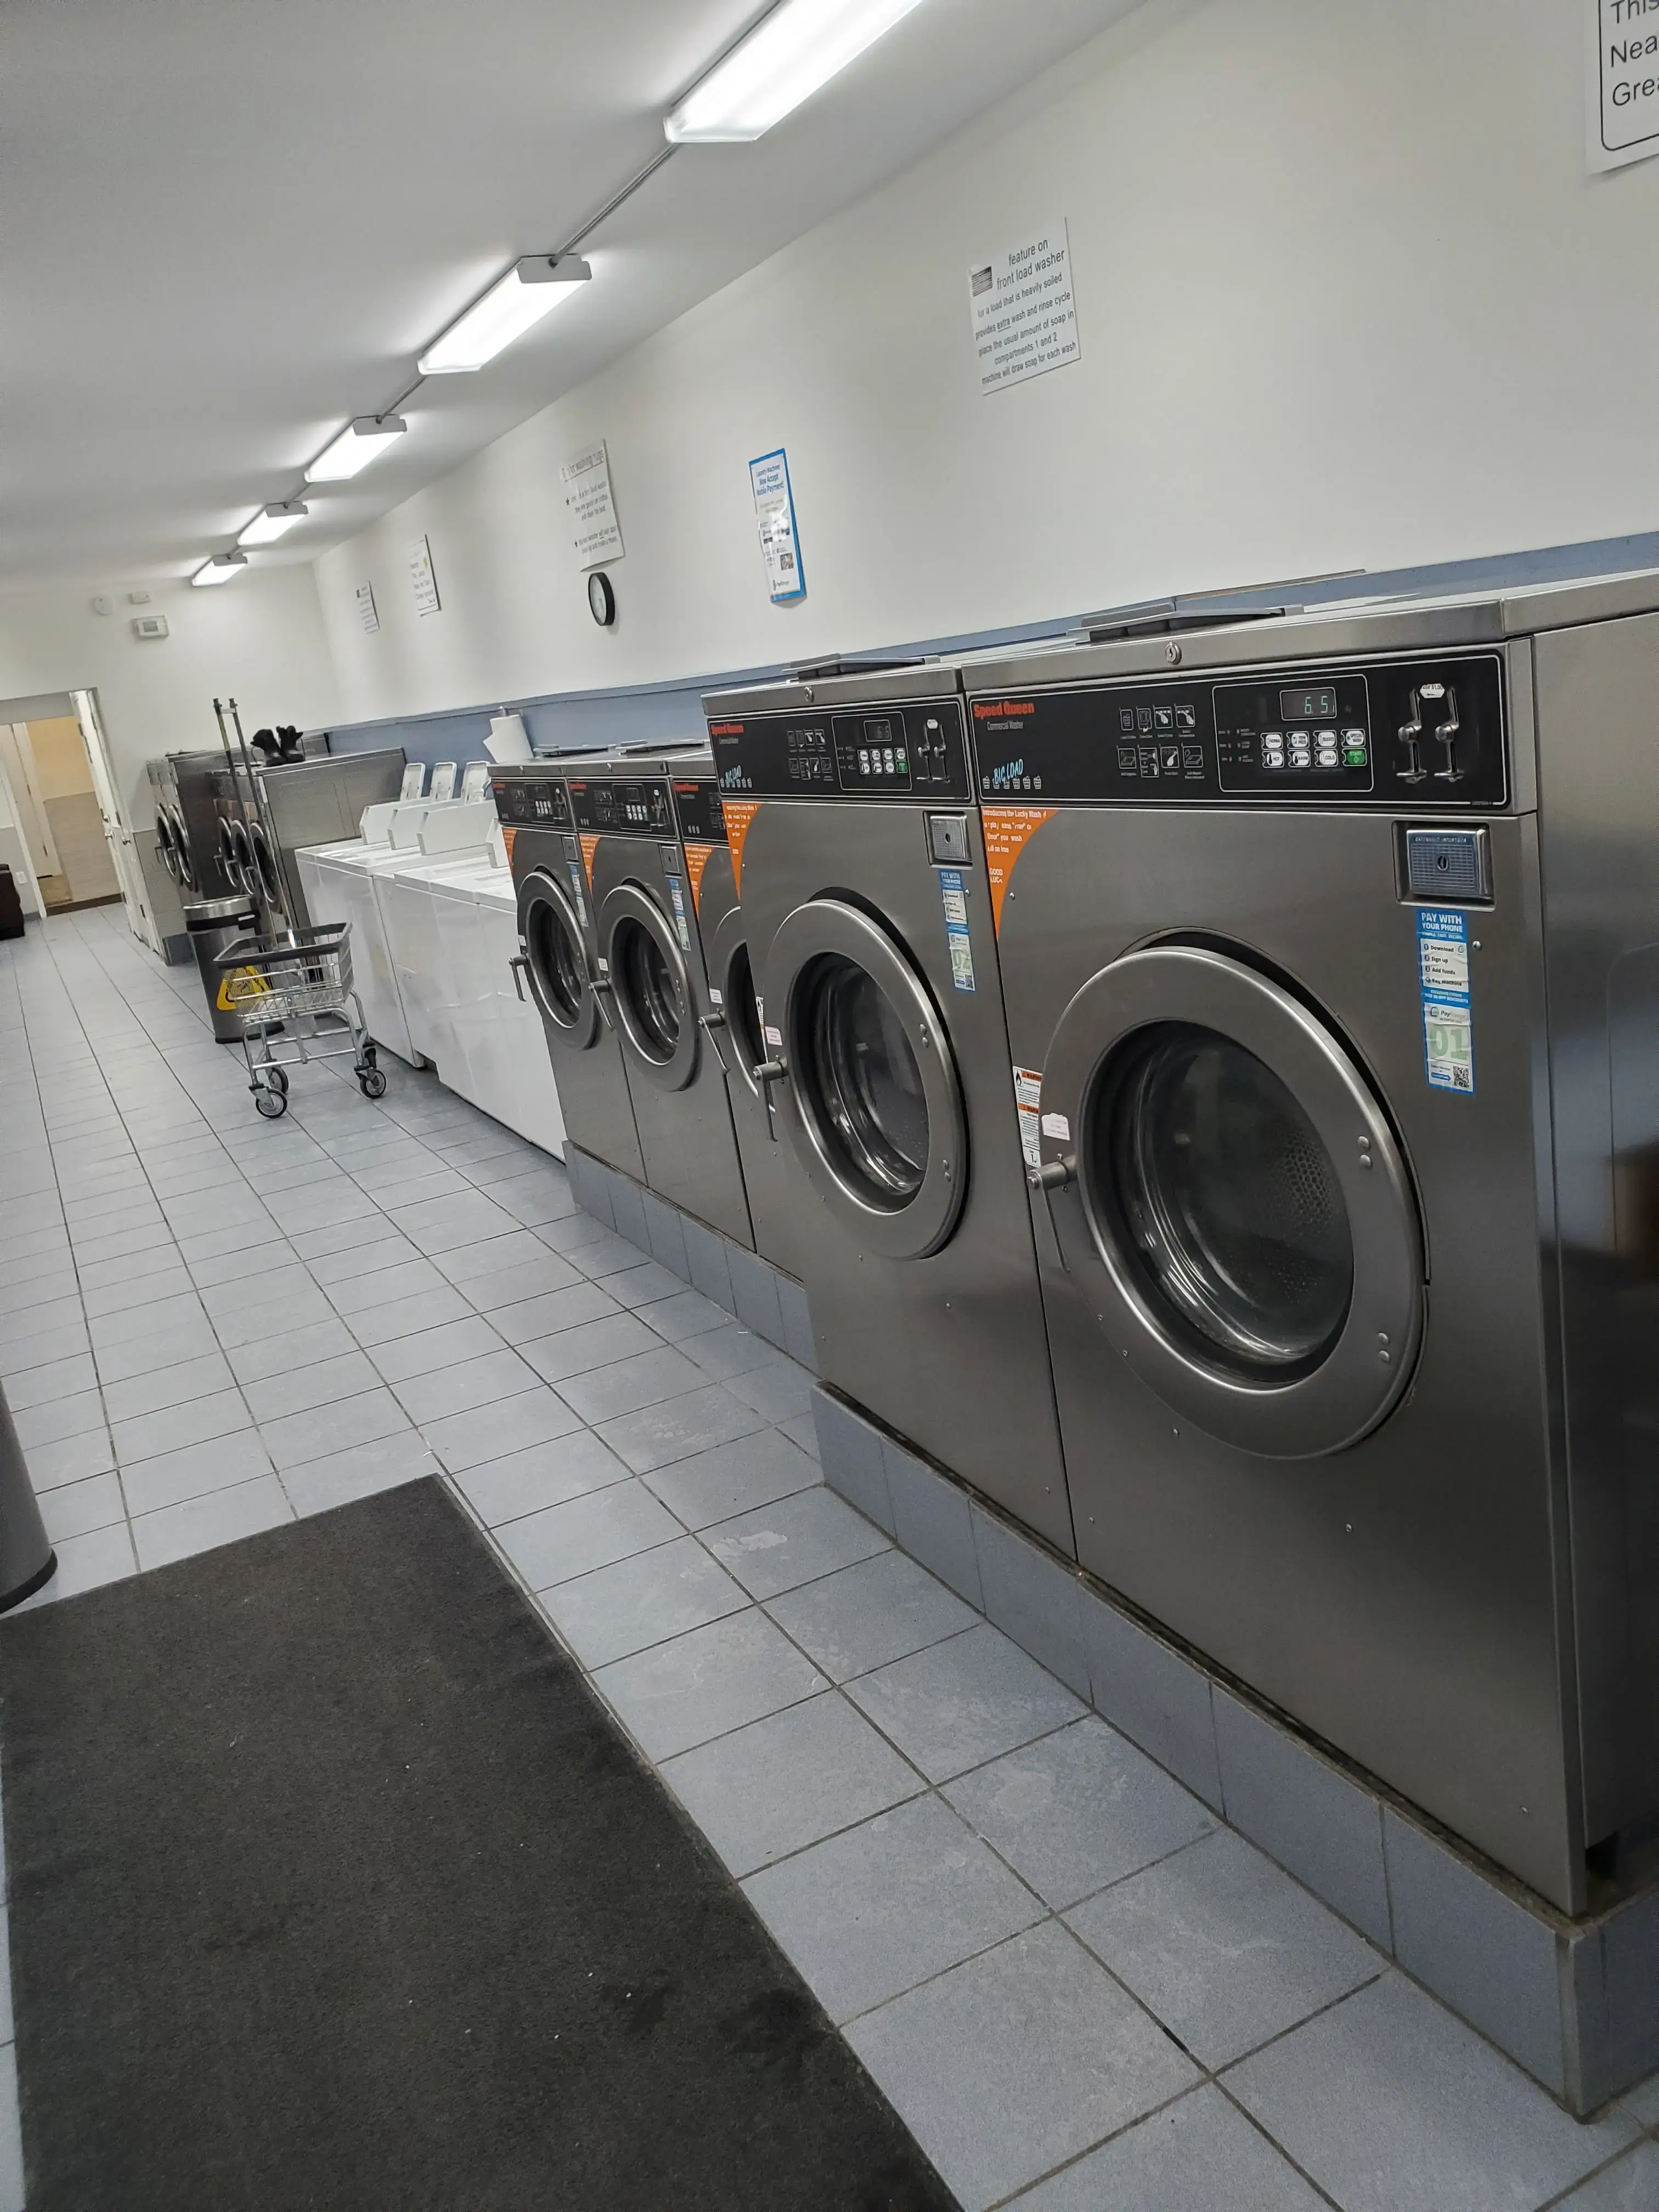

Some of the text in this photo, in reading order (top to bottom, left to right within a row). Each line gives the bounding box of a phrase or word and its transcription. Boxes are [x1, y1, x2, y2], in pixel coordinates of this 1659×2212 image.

[1612, 78, 1659, 106] Gre
[1008, 239, 1048, 266] feature on
[997, 250, 1065, 290] front load washer
[990, 300, 1002, 312] load
[1003, 295, 1014, 306] that
[1015, 291, 1021, 300] is
[1022, 282, 1042, 299] heavily
[1043, 272, 1062, 289] soiled
[975, 292, 1071, 341] provides extra wash and rinse cycle
[979, 309, 1074, 358] place the usual amount of soap in
[995, 332, 1058, 365] compartments 1 and 2
[982, 371, 1002, 385] machine
[1011, 362, 1024, 374] draw
[1025, 357, 1038, 369] soap
[1047, 347, 1060, 359] each
[1062, 341, 1076, 354] wash
[974, 701, 1035, 720] Speed Queen
[994, 758, 1024, 785] BIG LOAD
[1014, 810, 1028, 819] Lucky
[1029, 810, 1041, 819] Wash
[990, 868, 1003, 876] GOOD
[1421, 912, 1463, 925] PAY WITH
[1421, 922, 1463, 933] YOUR PHONE
[1429, 1024, 1470, 1060] 01
